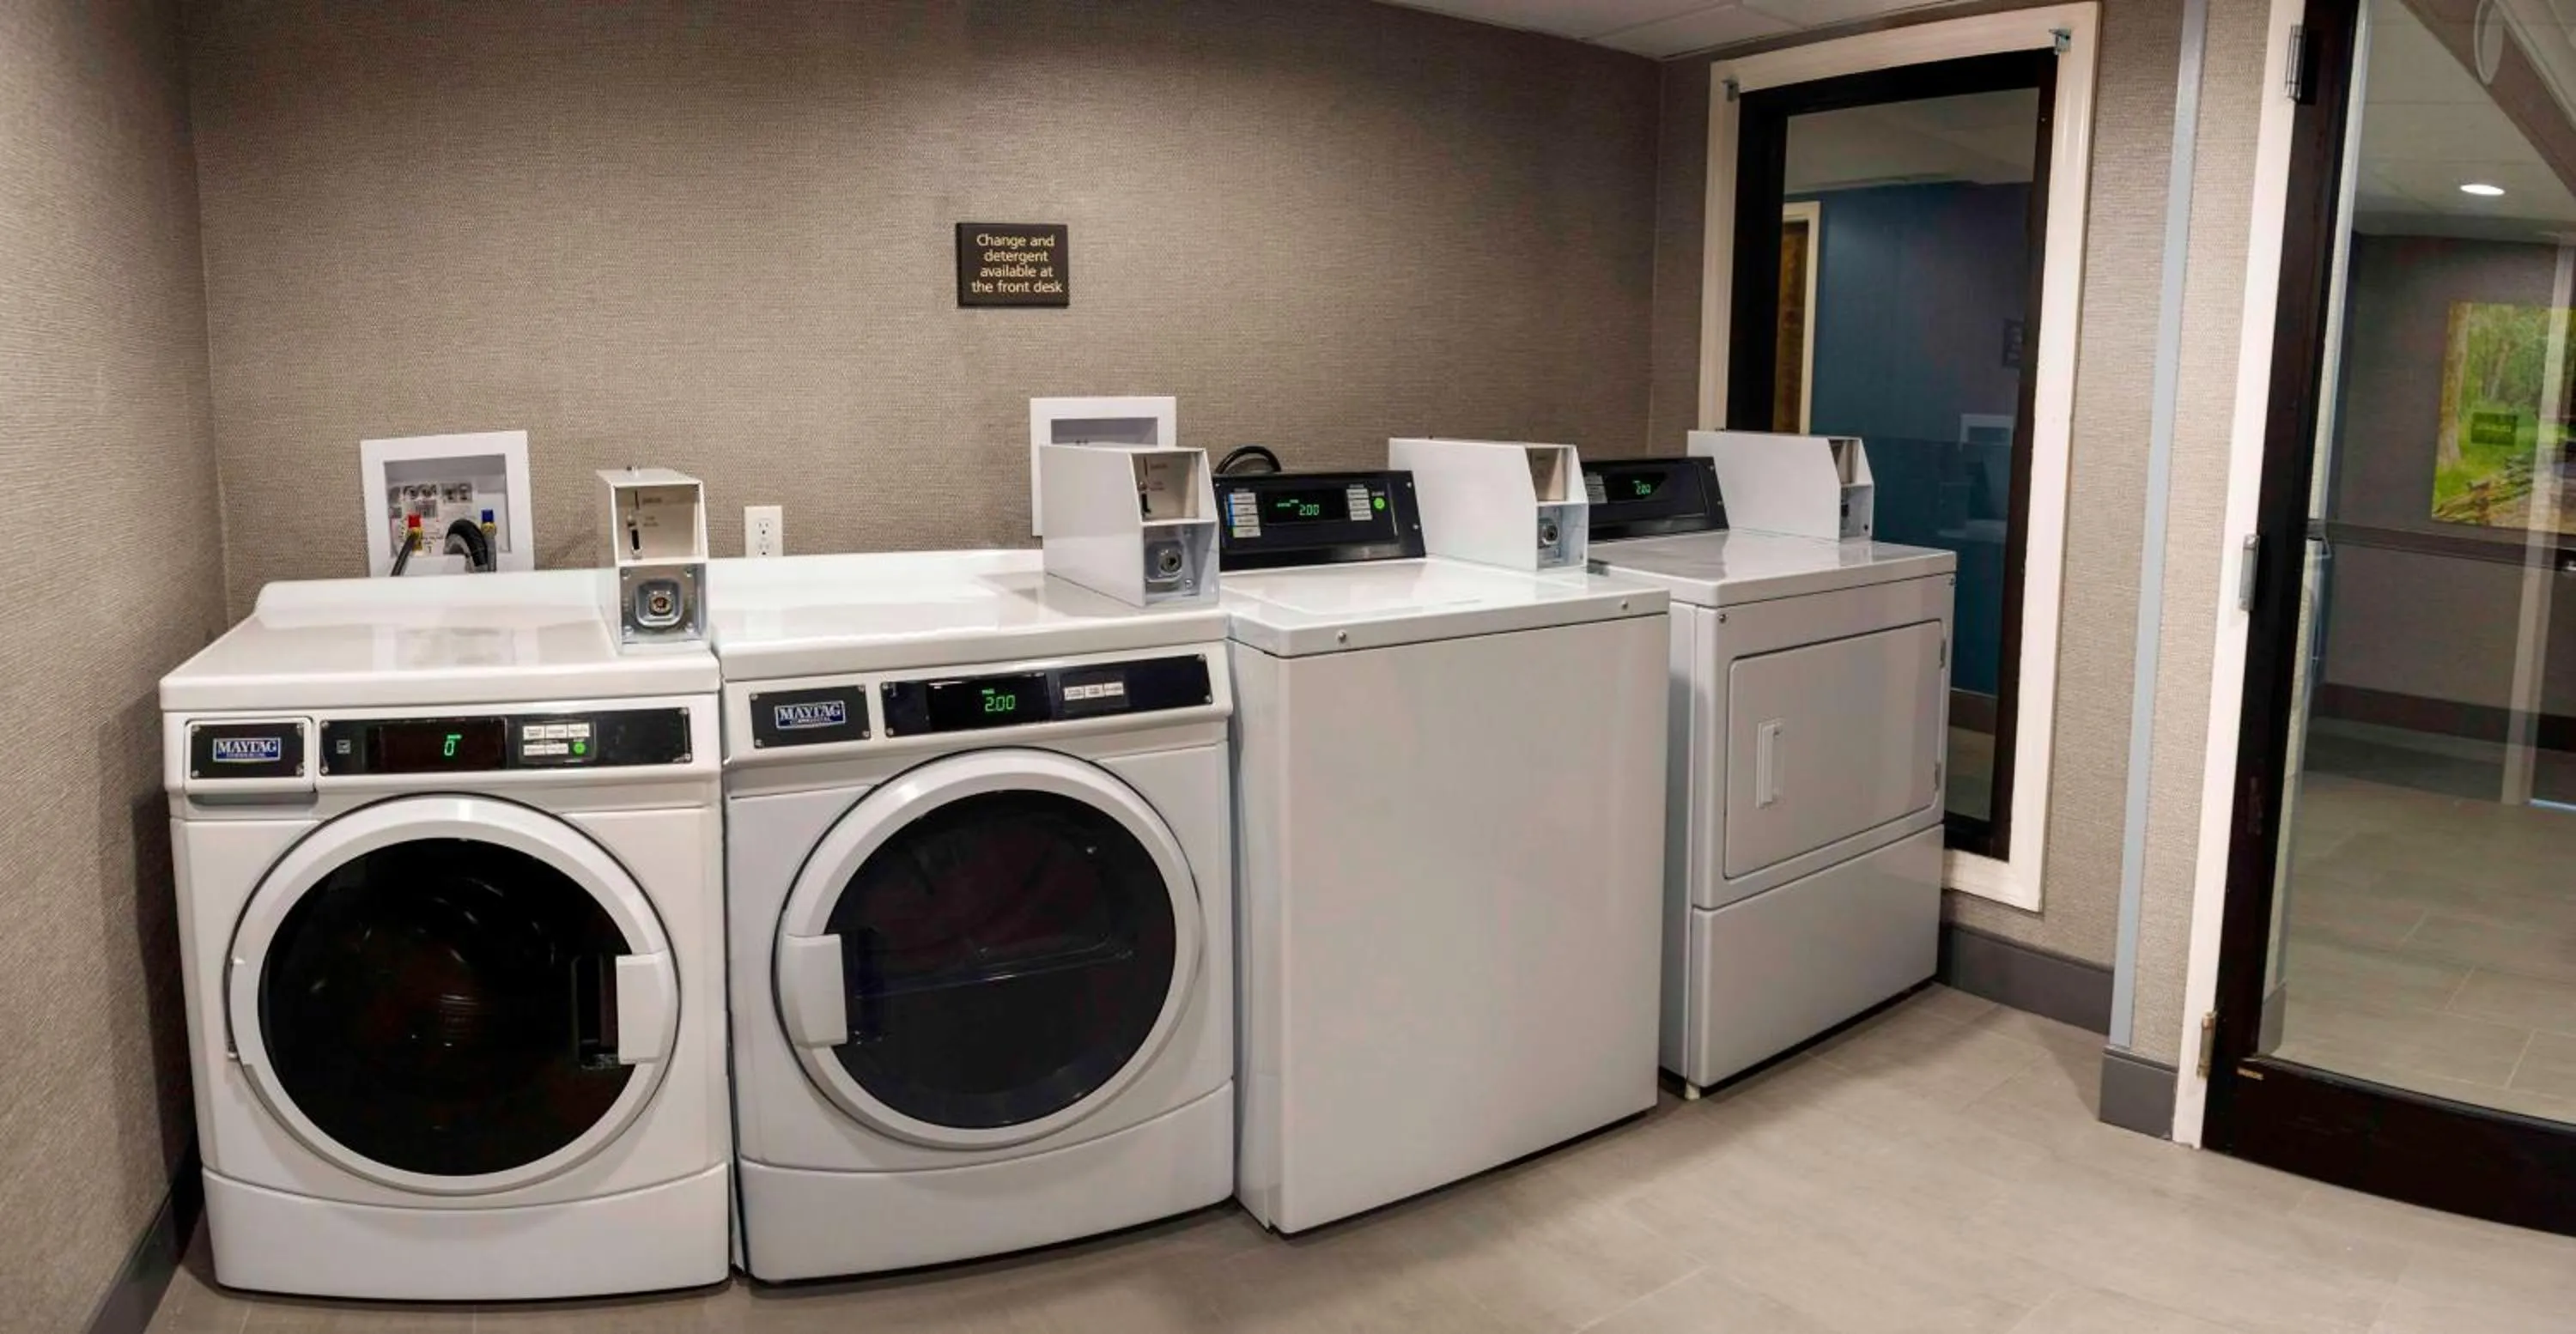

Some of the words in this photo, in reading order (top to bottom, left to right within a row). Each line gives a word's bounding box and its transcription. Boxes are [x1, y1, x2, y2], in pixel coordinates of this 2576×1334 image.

[976, 233, 1026, 250] Change
[1030, 234, 1055, 247] and
[983, 249, 1048, 265] detergent
[980, 264, 1036, 277] available
[1040, 266, 1054, 277] at
[971, 279, 993, 293] the
[998, 280, 1030, 293] front
[1033, 280, 1063, 293] desk
[778, 703, 842, 720] MAYTAG
[217, 741, 277, 754] MAYTAG
